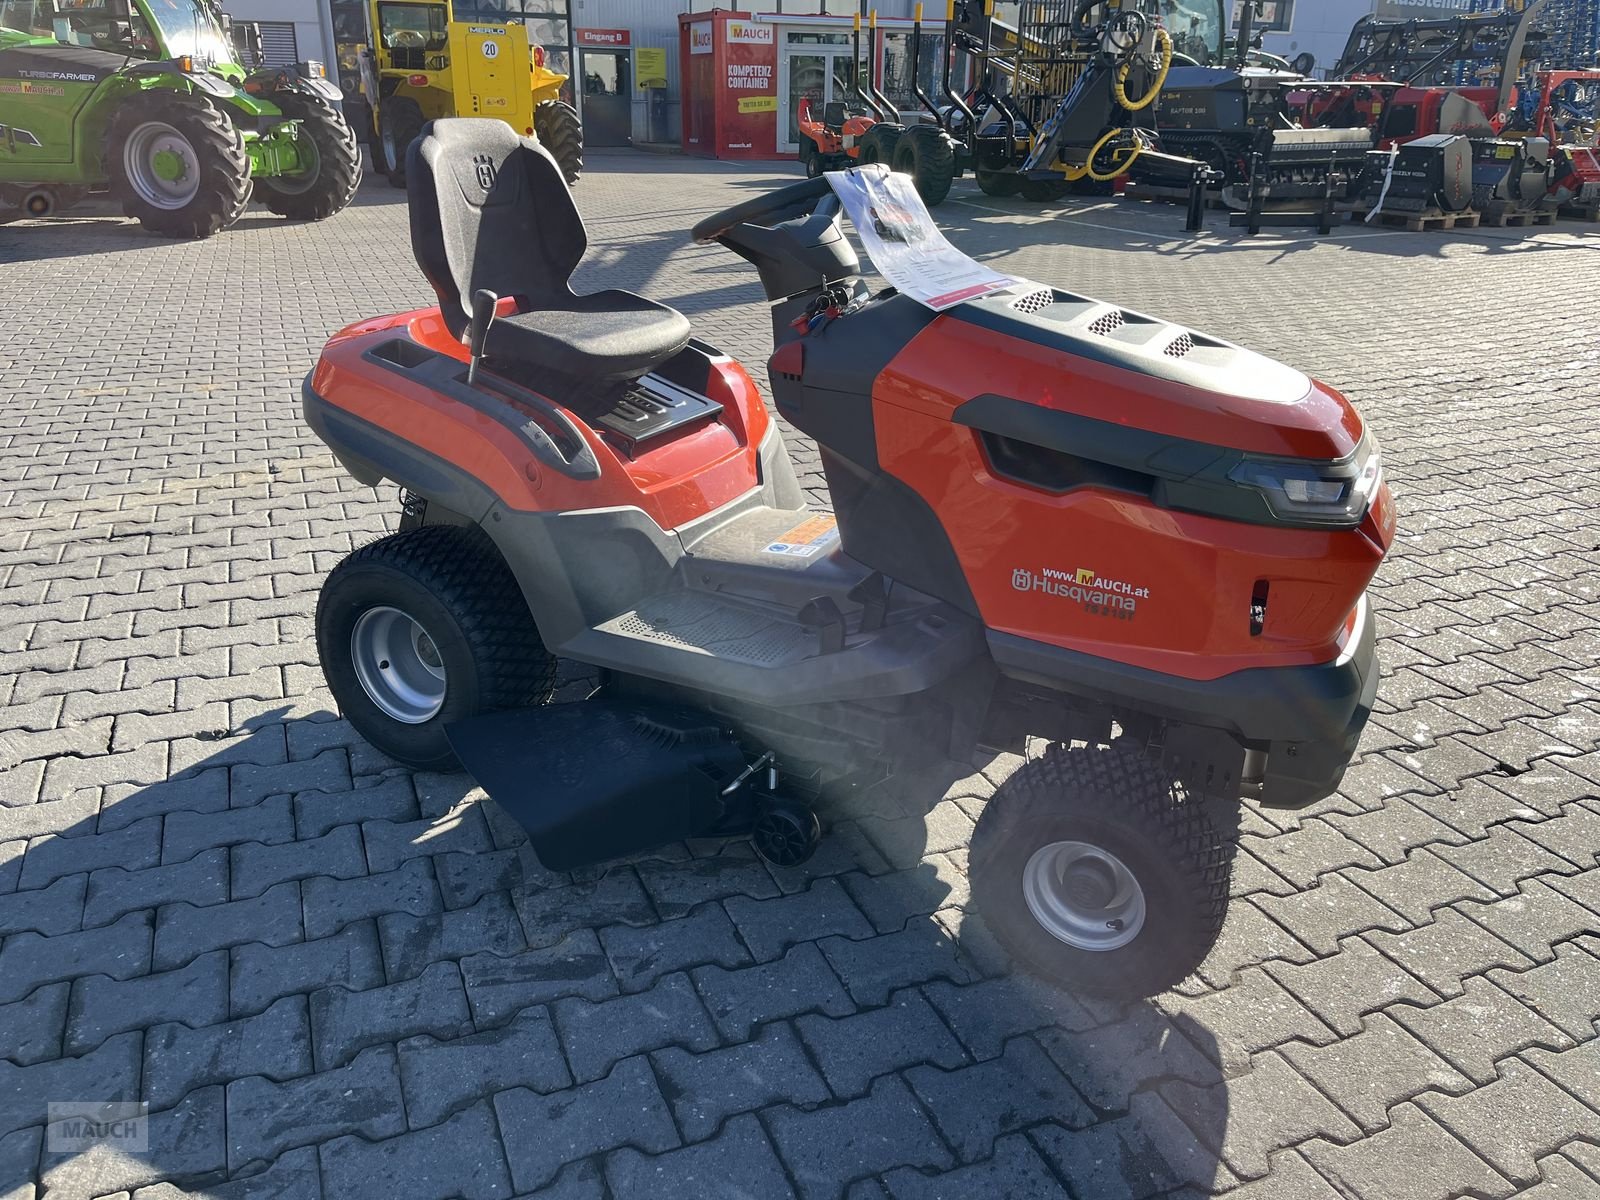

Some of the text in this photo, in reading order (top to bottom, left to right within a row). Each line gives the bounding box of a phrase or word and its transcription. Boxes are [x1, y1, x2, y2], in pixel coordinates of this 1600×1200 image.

[584, 32, 622, 42] Eingang B
[733, 27, 770, 39] MAUCH
[484, 43, 496, 56] 20
[19, 70, 96, 81] TURBOFARMER
[728, 65, 772, 77] KOMPETENZ
[728, 77, 769, 89] CONTAINER
[1042, 568, 1149, 598] www.MAUCH.at
[1033, 575, 1136, 611] Husqvarna
